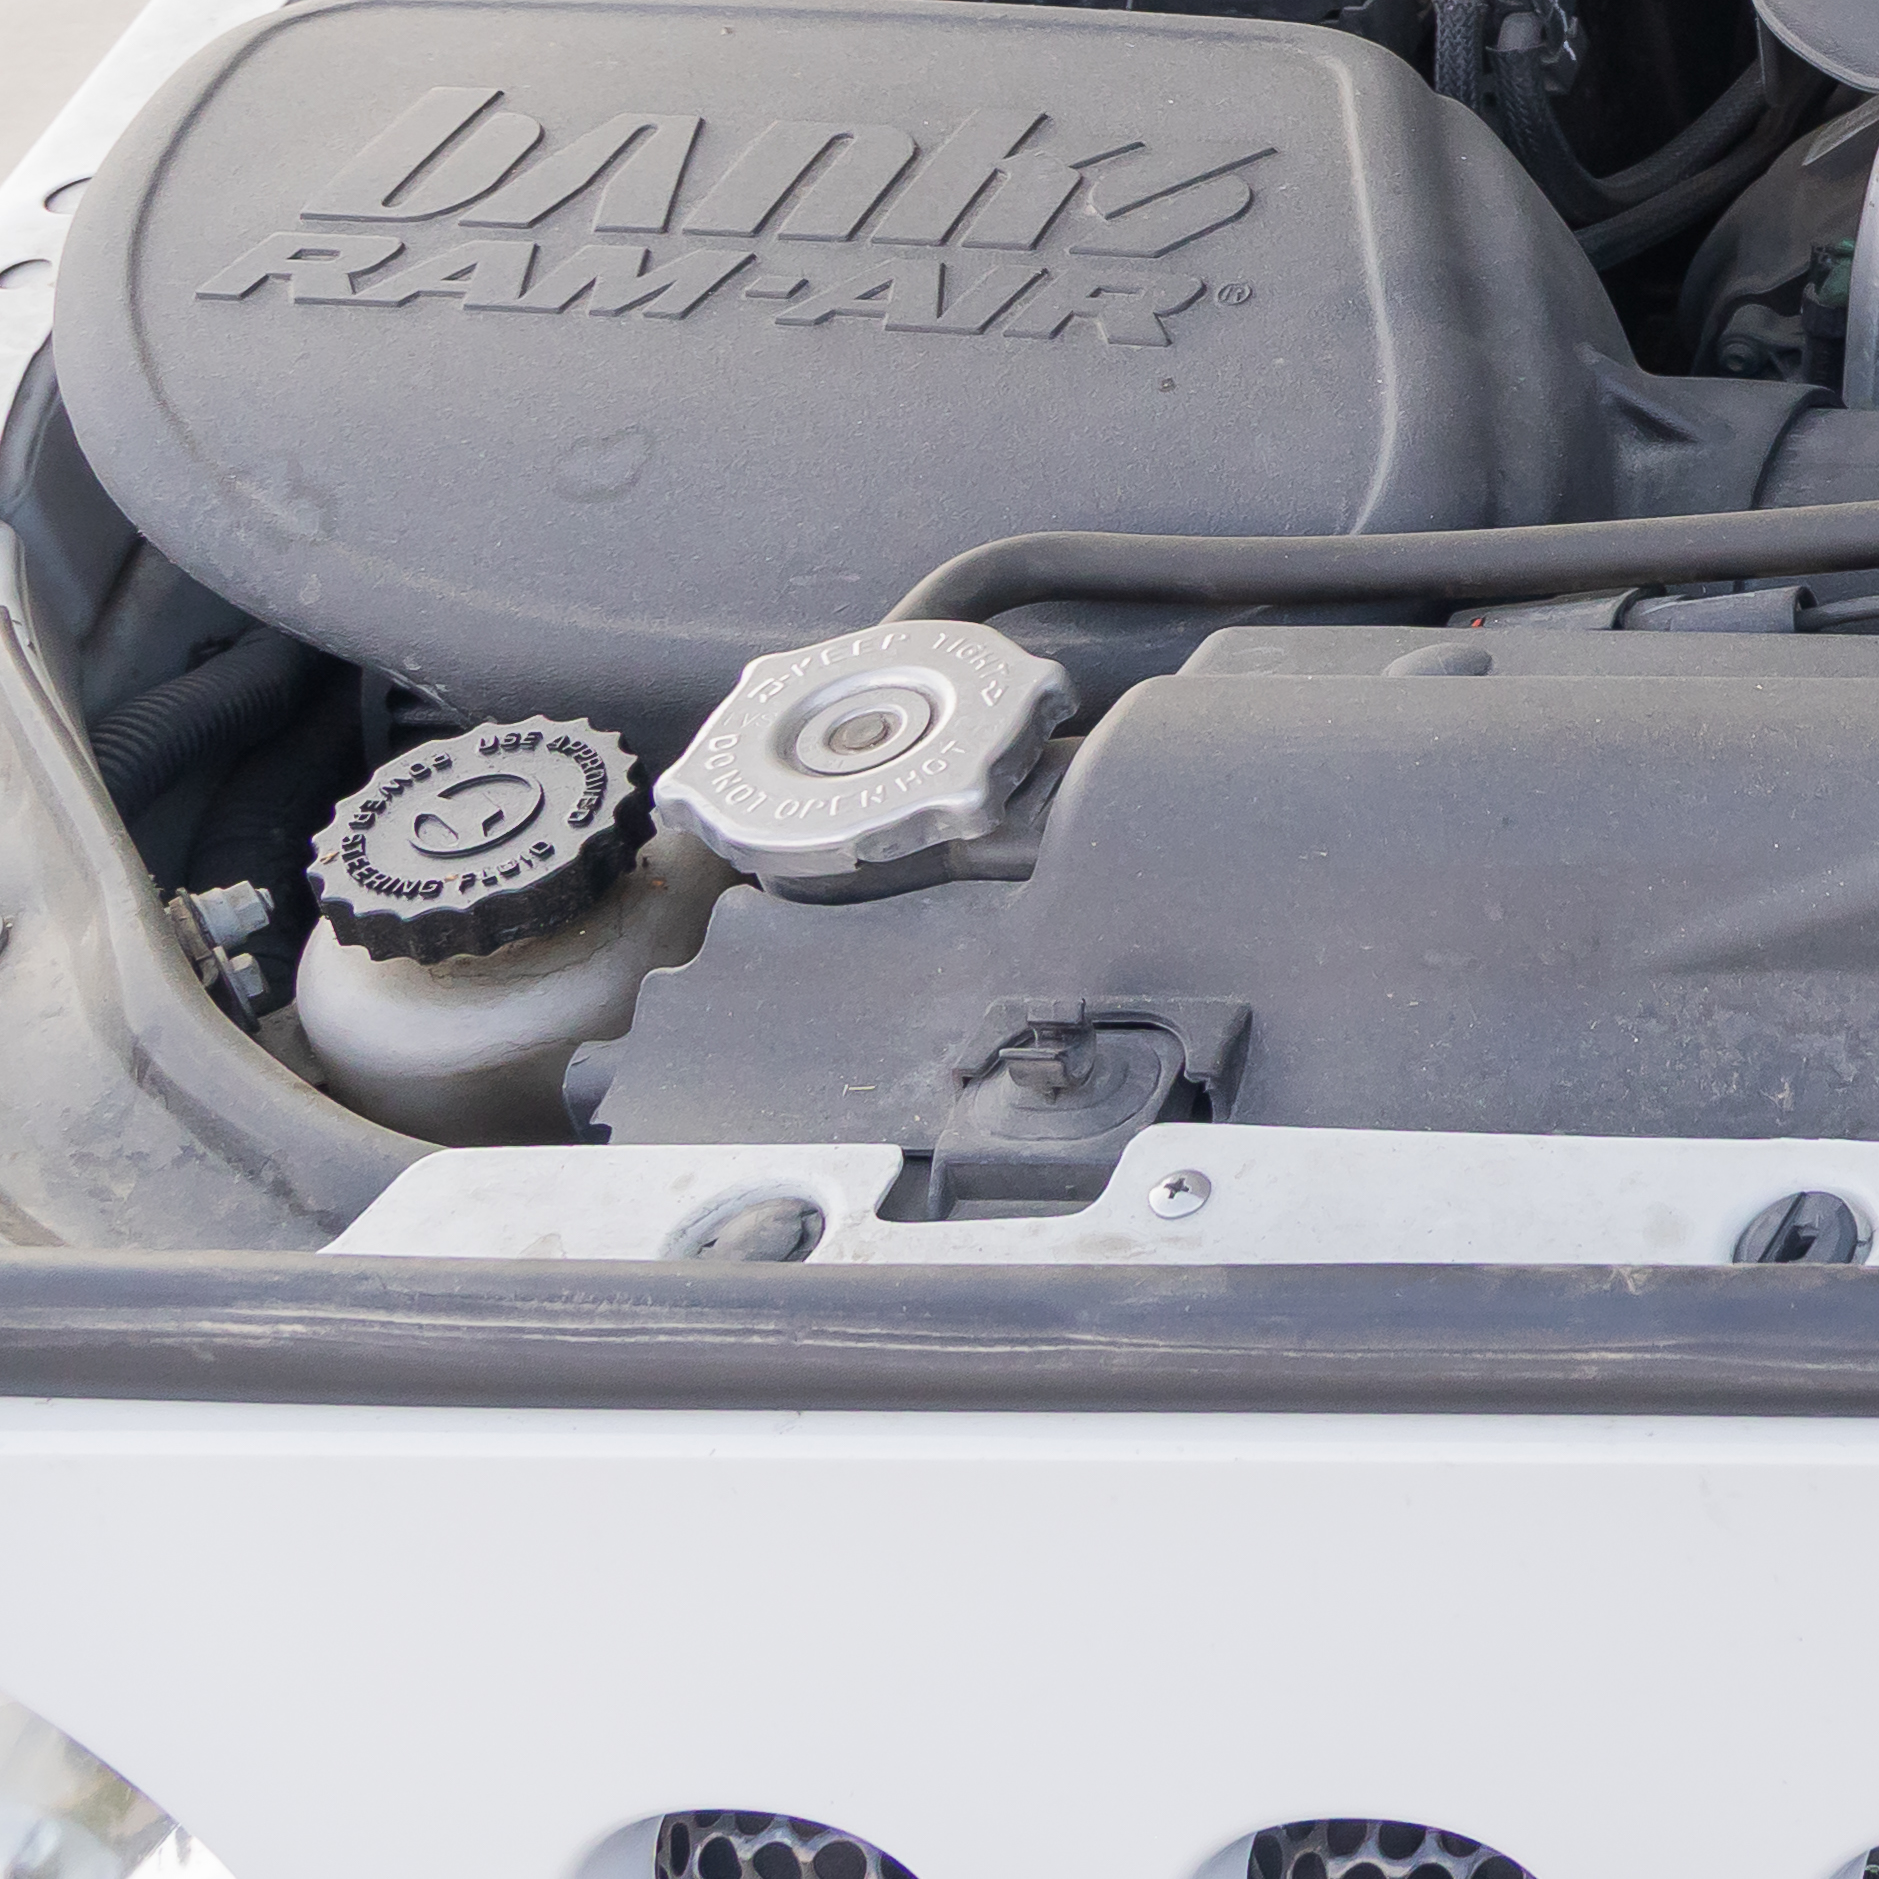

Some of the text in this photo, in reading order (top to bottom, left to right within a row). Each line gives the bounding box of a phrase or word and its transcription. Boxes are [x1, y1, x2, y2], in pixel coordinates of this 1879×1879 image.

[477, 730, 544, 756] USE
[546, 734, 609, 828] APPROVED
[703, 733, 967, 821] DO NOT OPEN HOT
[341, 833, 444, 900] STEERING
[458, 840, 556, 895] FLUID
